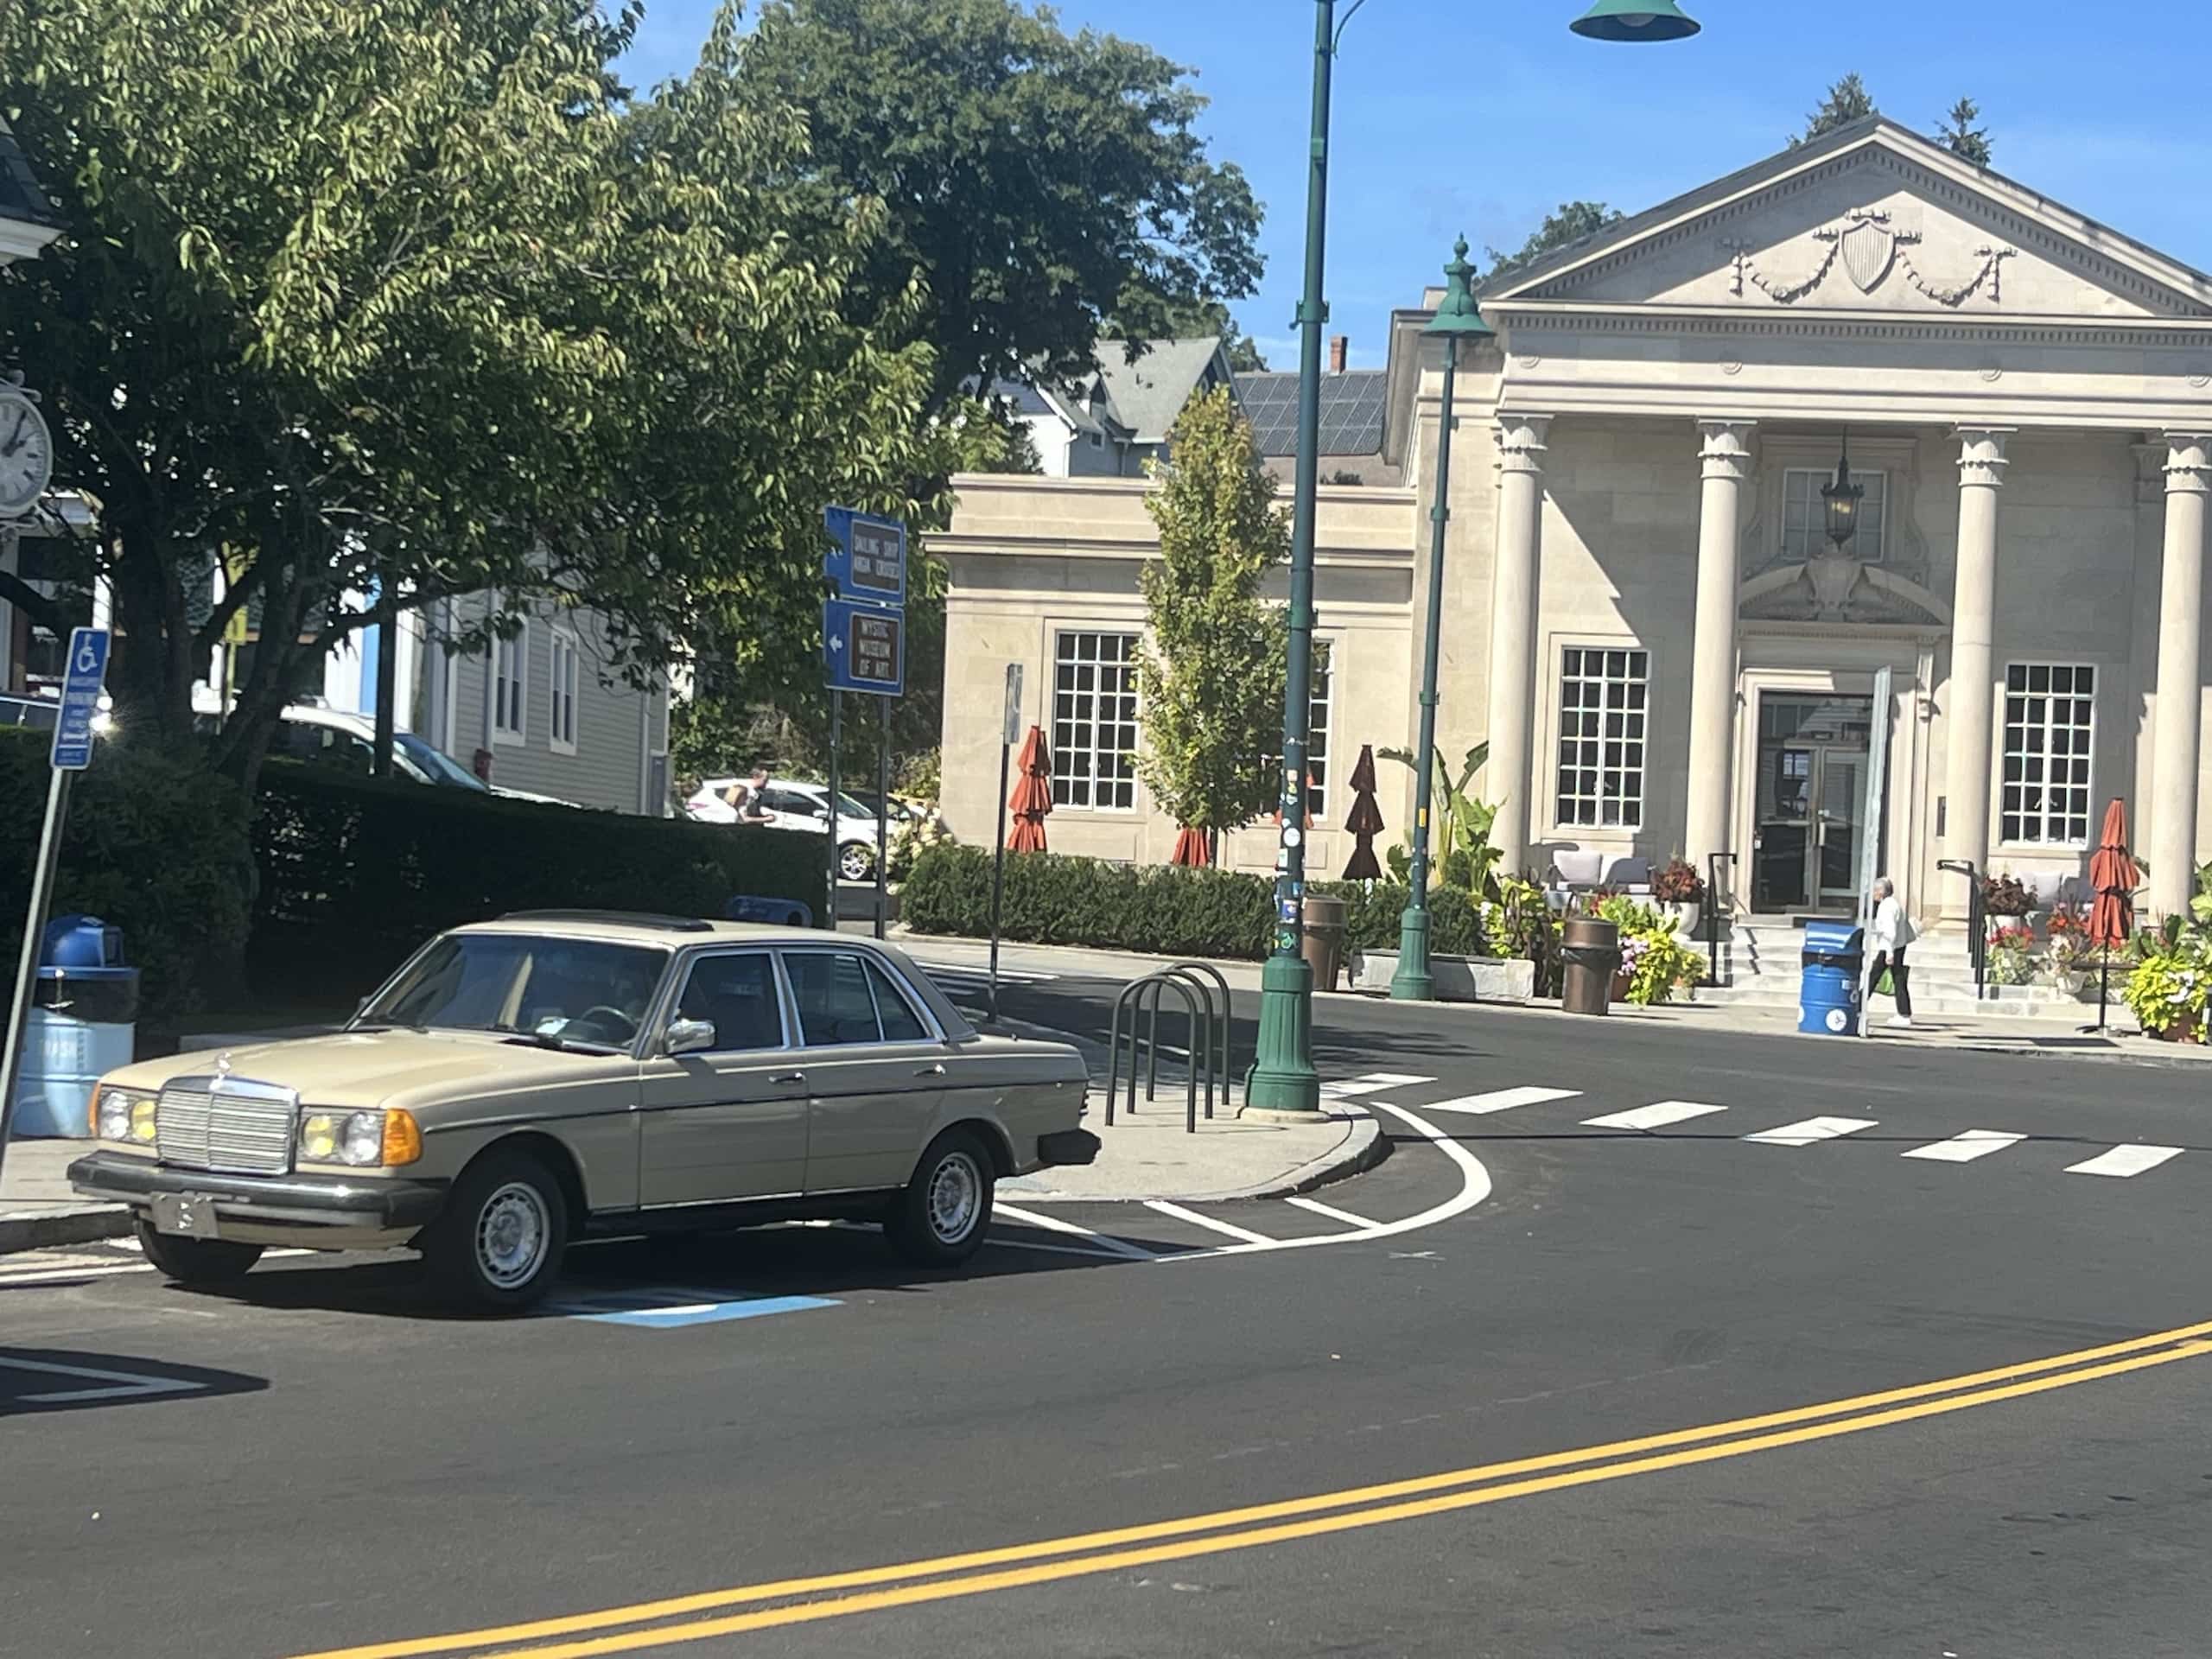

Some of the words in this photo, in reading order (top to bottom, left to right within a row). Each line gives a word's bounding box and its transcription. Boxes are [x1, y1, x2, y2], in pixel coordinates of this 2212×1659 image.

[861, 620, 889, 637] MYSTIC
[858, 638, 891, 658] MUSEUM
[859, 658, 870, 675] OF
[874, 661, 890, 677] ART
